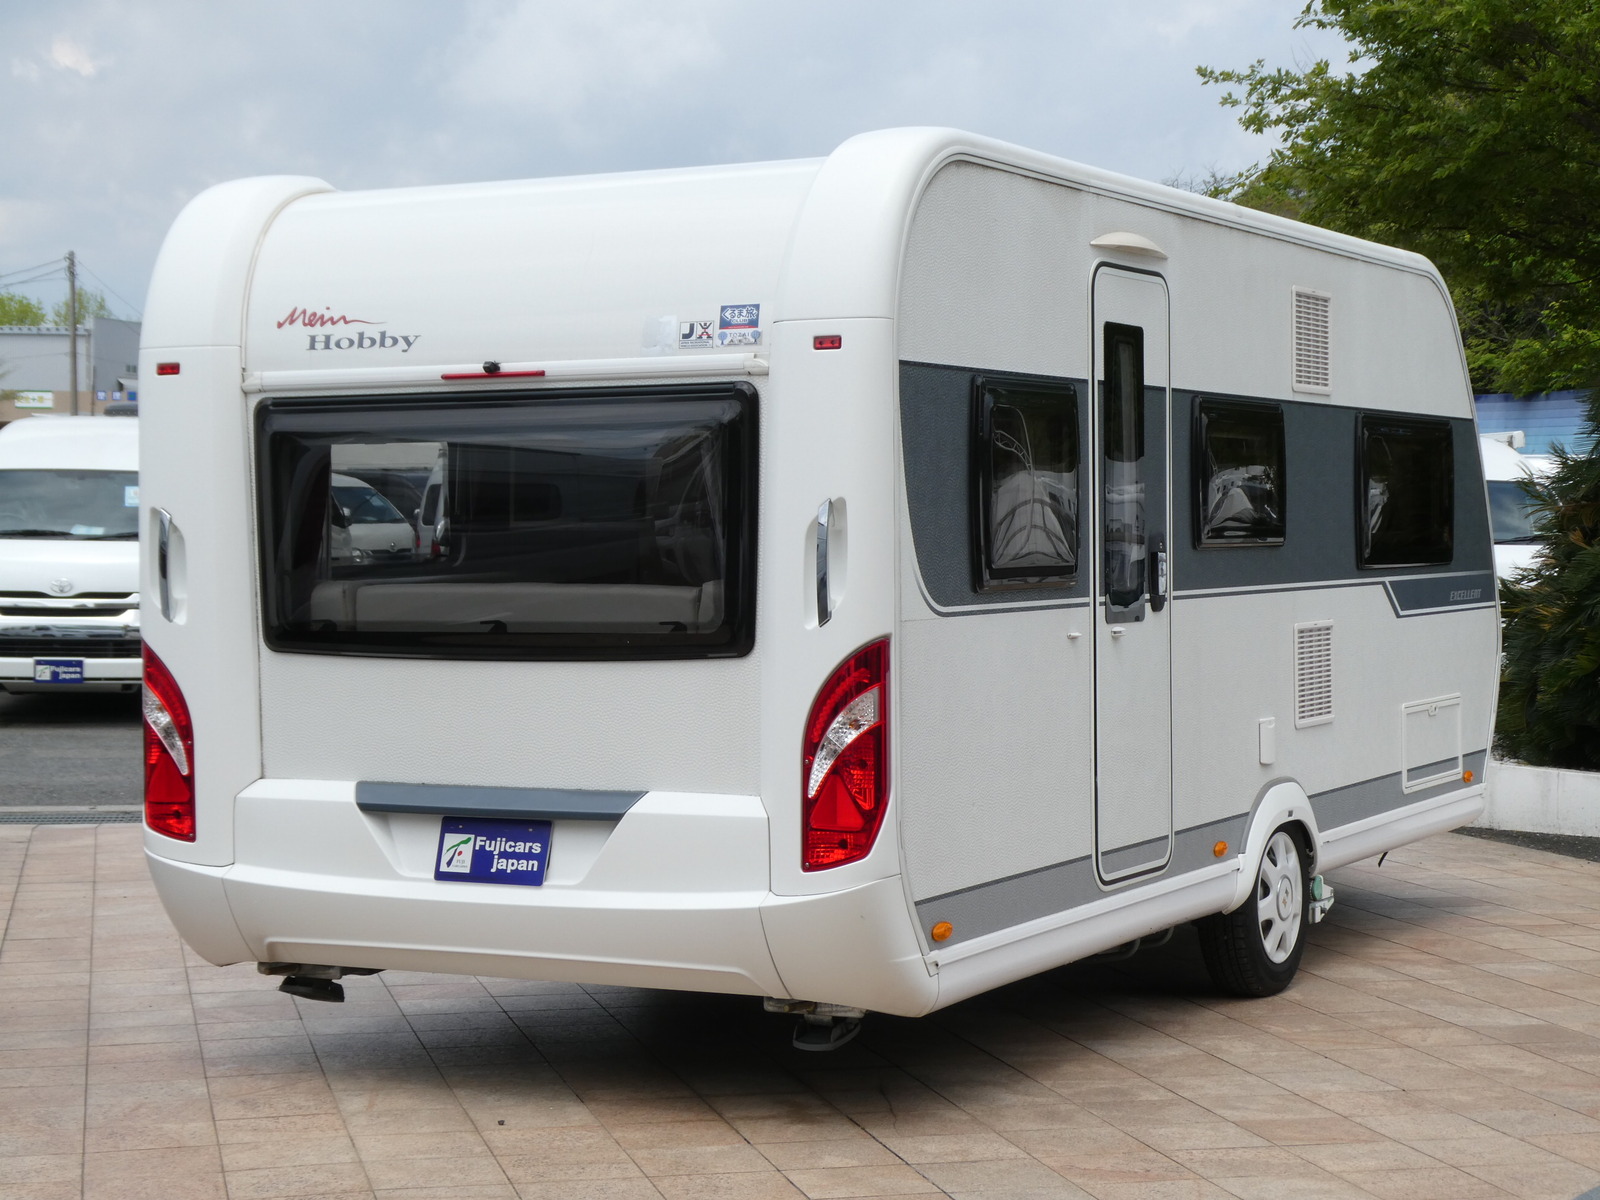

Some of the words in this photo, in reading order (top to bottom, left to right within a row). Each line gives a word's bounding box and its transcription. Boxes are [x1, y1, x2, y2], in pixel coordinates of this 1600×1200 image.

[276, 306, 388, 329] Mein
[722, 306, 758, 320] くるま旅
[306, 330, 421, 352] Hobby
[1450, 589, 1482, 600] EXCELLENT
[50, 665, 81, 673] Fujicars
[475, 836, 541, 854] Fujicars
[490, 855, 538, 873] japan
